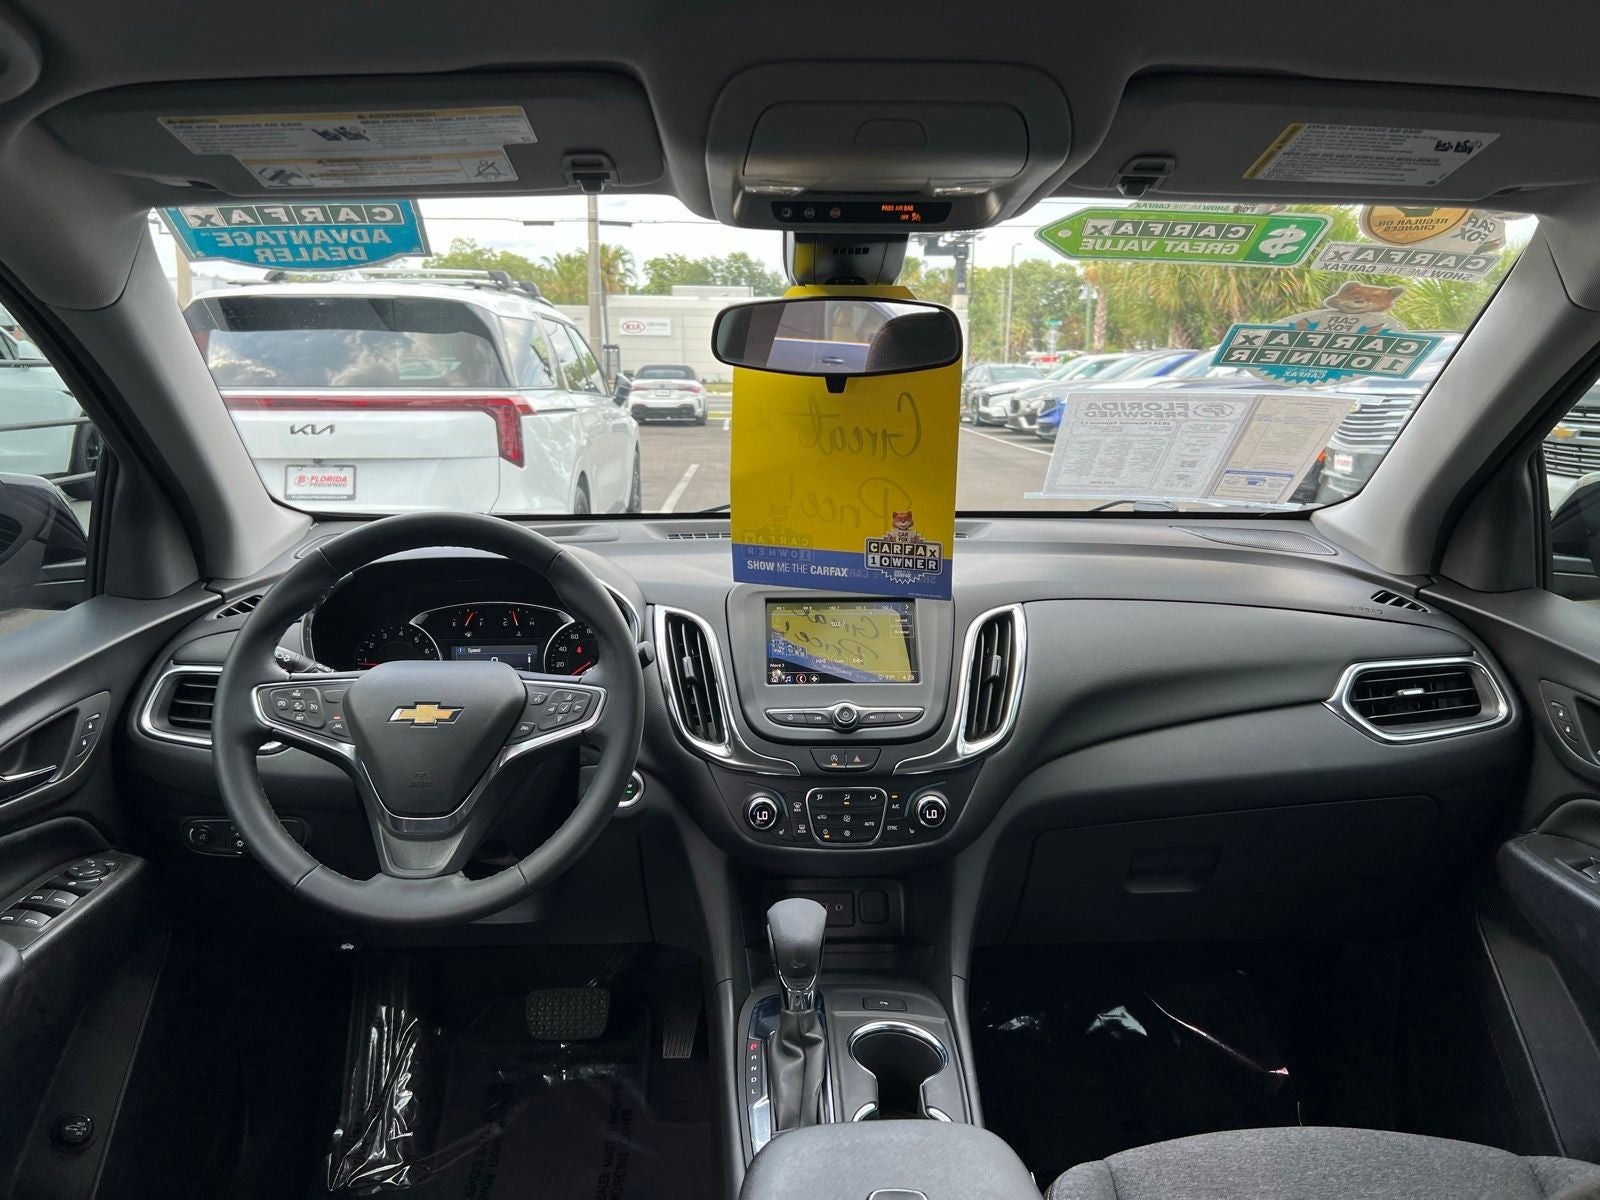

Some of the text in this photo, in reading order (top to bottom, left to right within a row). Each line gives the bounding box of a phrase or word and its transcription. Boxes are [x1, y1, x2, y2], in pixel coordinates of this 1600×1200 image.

[290, 424, 335, 435] KIA
[870, 543, 936, 557] CARFAX
[747, 560, 775, 571] SHOW
[777, 562, 789, 572] ME
[792, 563, 808, 574] THE
[810, 565, 848, 578] CARFAX
